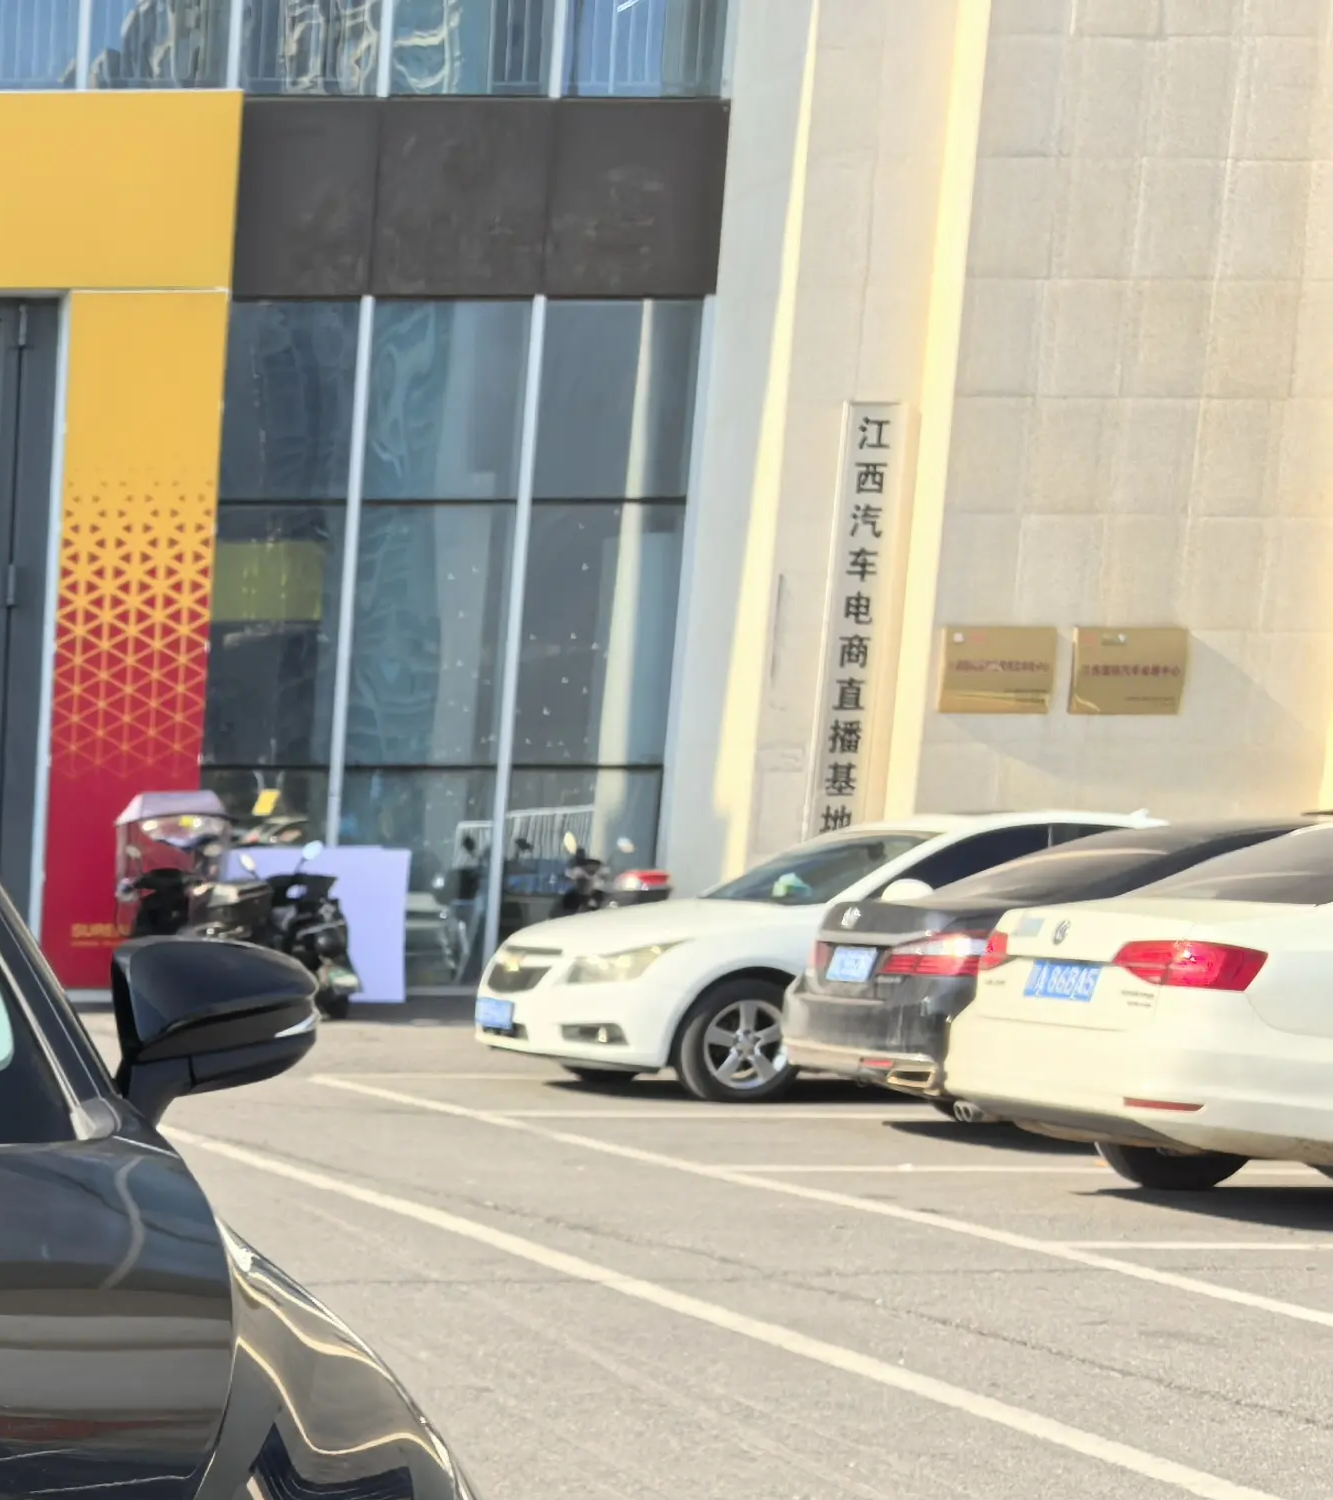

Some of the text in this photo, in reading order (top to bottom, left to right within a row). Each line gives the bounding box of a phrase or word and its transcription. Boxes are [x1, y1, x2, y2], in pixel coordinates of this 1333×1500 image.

[819, 416, 891, 834] 江西汽车电商直播基地
